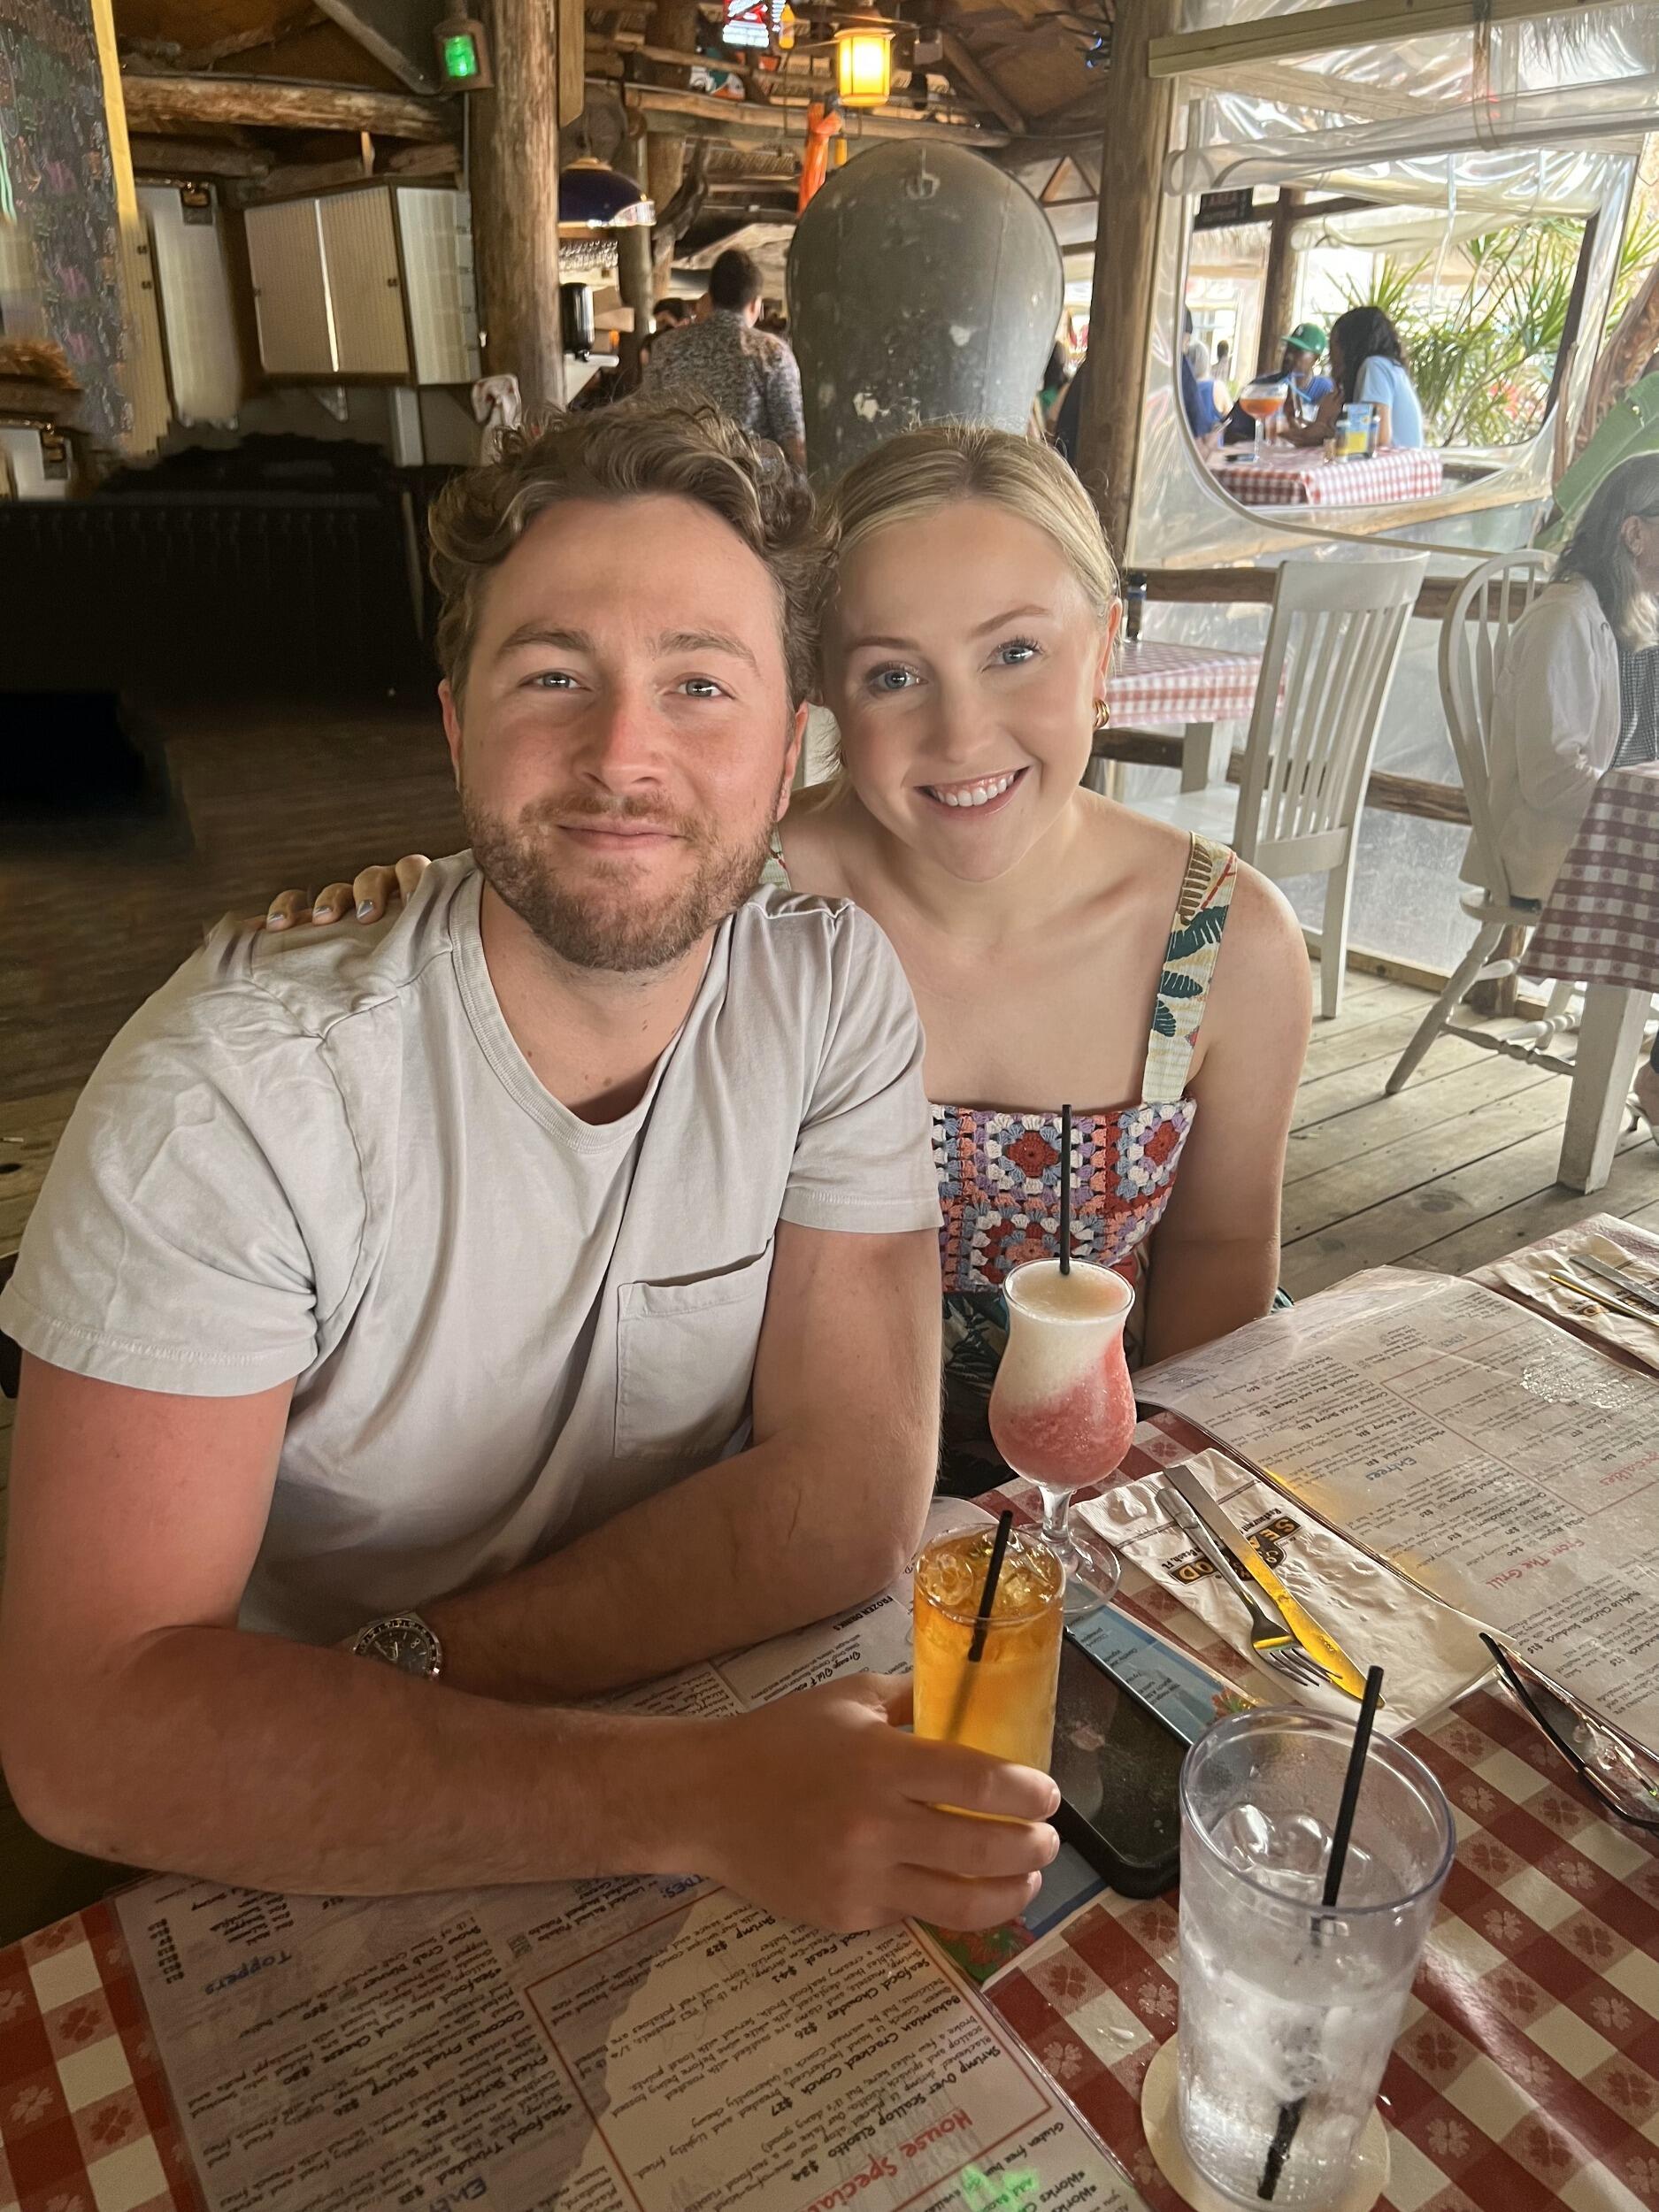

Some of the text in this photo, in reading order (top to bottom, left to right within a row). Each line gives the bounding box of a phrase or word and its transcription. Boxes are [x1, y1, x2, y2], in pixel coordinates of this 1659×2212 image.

[1272, 1398, 1298, 1409] Cheese
[1339, 1404, 1359, 1414] Fried
[1359, 1392, 1388, 1405] Coconut
[1308, 1411, 1339, 1423] Shrimp
[1372, 1419, 1397, 1430] Shrimp
[1396, 1410, 1417, 1421] Fried
[1382, 1444, 1415, 1460] Trinidad
[1365, 1456, 1417, 1480] Entrees
[1242, 1509, 1288, 1532] Restaurant
[1486, 1538, 1585, 1589] From The Grill
[833, 1595, 894, 1631] FROZEN DRINKS
[1580, 1606, 1612, 1624] Chicken
[1544, 1623, 1581, 1643] Sandwich
[527, 1916, 563, 1936] Potato
[537, 1923, 573, 1942] Potato
[735, 1914, 777, 1939] Shrimp
[759, 1932, 792, 1953] butter
[204, 1949, 293, 1995] Toppers
[362, 1924, 482, 1991] Snow Crab Dinner
[550, 1919, 722, 2013] sauce and served with yellow rice
[550, 1910, 761, 2027] with our unique conch and
[771, 1942, 839, 1985] Feast $41
[729, 1975, 751, 1993] 1/4
[794, 1957, 931, 2039] Seafood Chowder $26
[667, 1937, 895, 2073] with creamy seafood Served with toast
[320, 2000, 436, 2064] Mac and Cheese
[466, 2009, 526, 2047] Coconut
[572, 1968, 748, 2072] corn and red potatoes are tossed
[610, 1939, 914, 2119] vegetables then deglazed with white wine before being tossed
[946, 2015, 979, 2035] broke
[422, 2042, 464, 2071] Fried
[664, 1991, 846, 2102] and clams are with roasted
[771, 1994, 961, 2117] Bahamian Cracked Conch $27
[918, 2037, 938, 2054] few
[958, 2045, 1002, 2074] Shrimp
[508, 2054, 549, 2083] Fried
[690, 2003, 901, 2130] but be warned Conch inherently chewy
[890, 2051, 917, 2071] rules
[364, 2066, 419, 2097] Shrimp
[458, 2077, 507, 2108] Shrimp
[668, 2004, 920, 2157] Conch hand breaded and lightly
[844, 2085, 864, 2101] but
[902, 2068, 936, 2093] shrimp
[928, 2072, 957, 2095] Over
[724, 2024, 984, 2193] scallop and spinach Our take on seafood
[794, 2108, 824, 2130] dang
[825, 2097, 845, 2112] it's
[850, 2096, 886, 2128] placed
[868, 2093, 927, 2127] Scallop
[822, 2124, 849, 2145] atop
[827, 2124, 877, 2158] Risotto
[897, 2108, 973, 2158] House
[1027, 2121, 1064, 2147] Gluten
[434, 2141, 505, 2186] Trinidad
[1003, 2144, 1028, 2164] free
